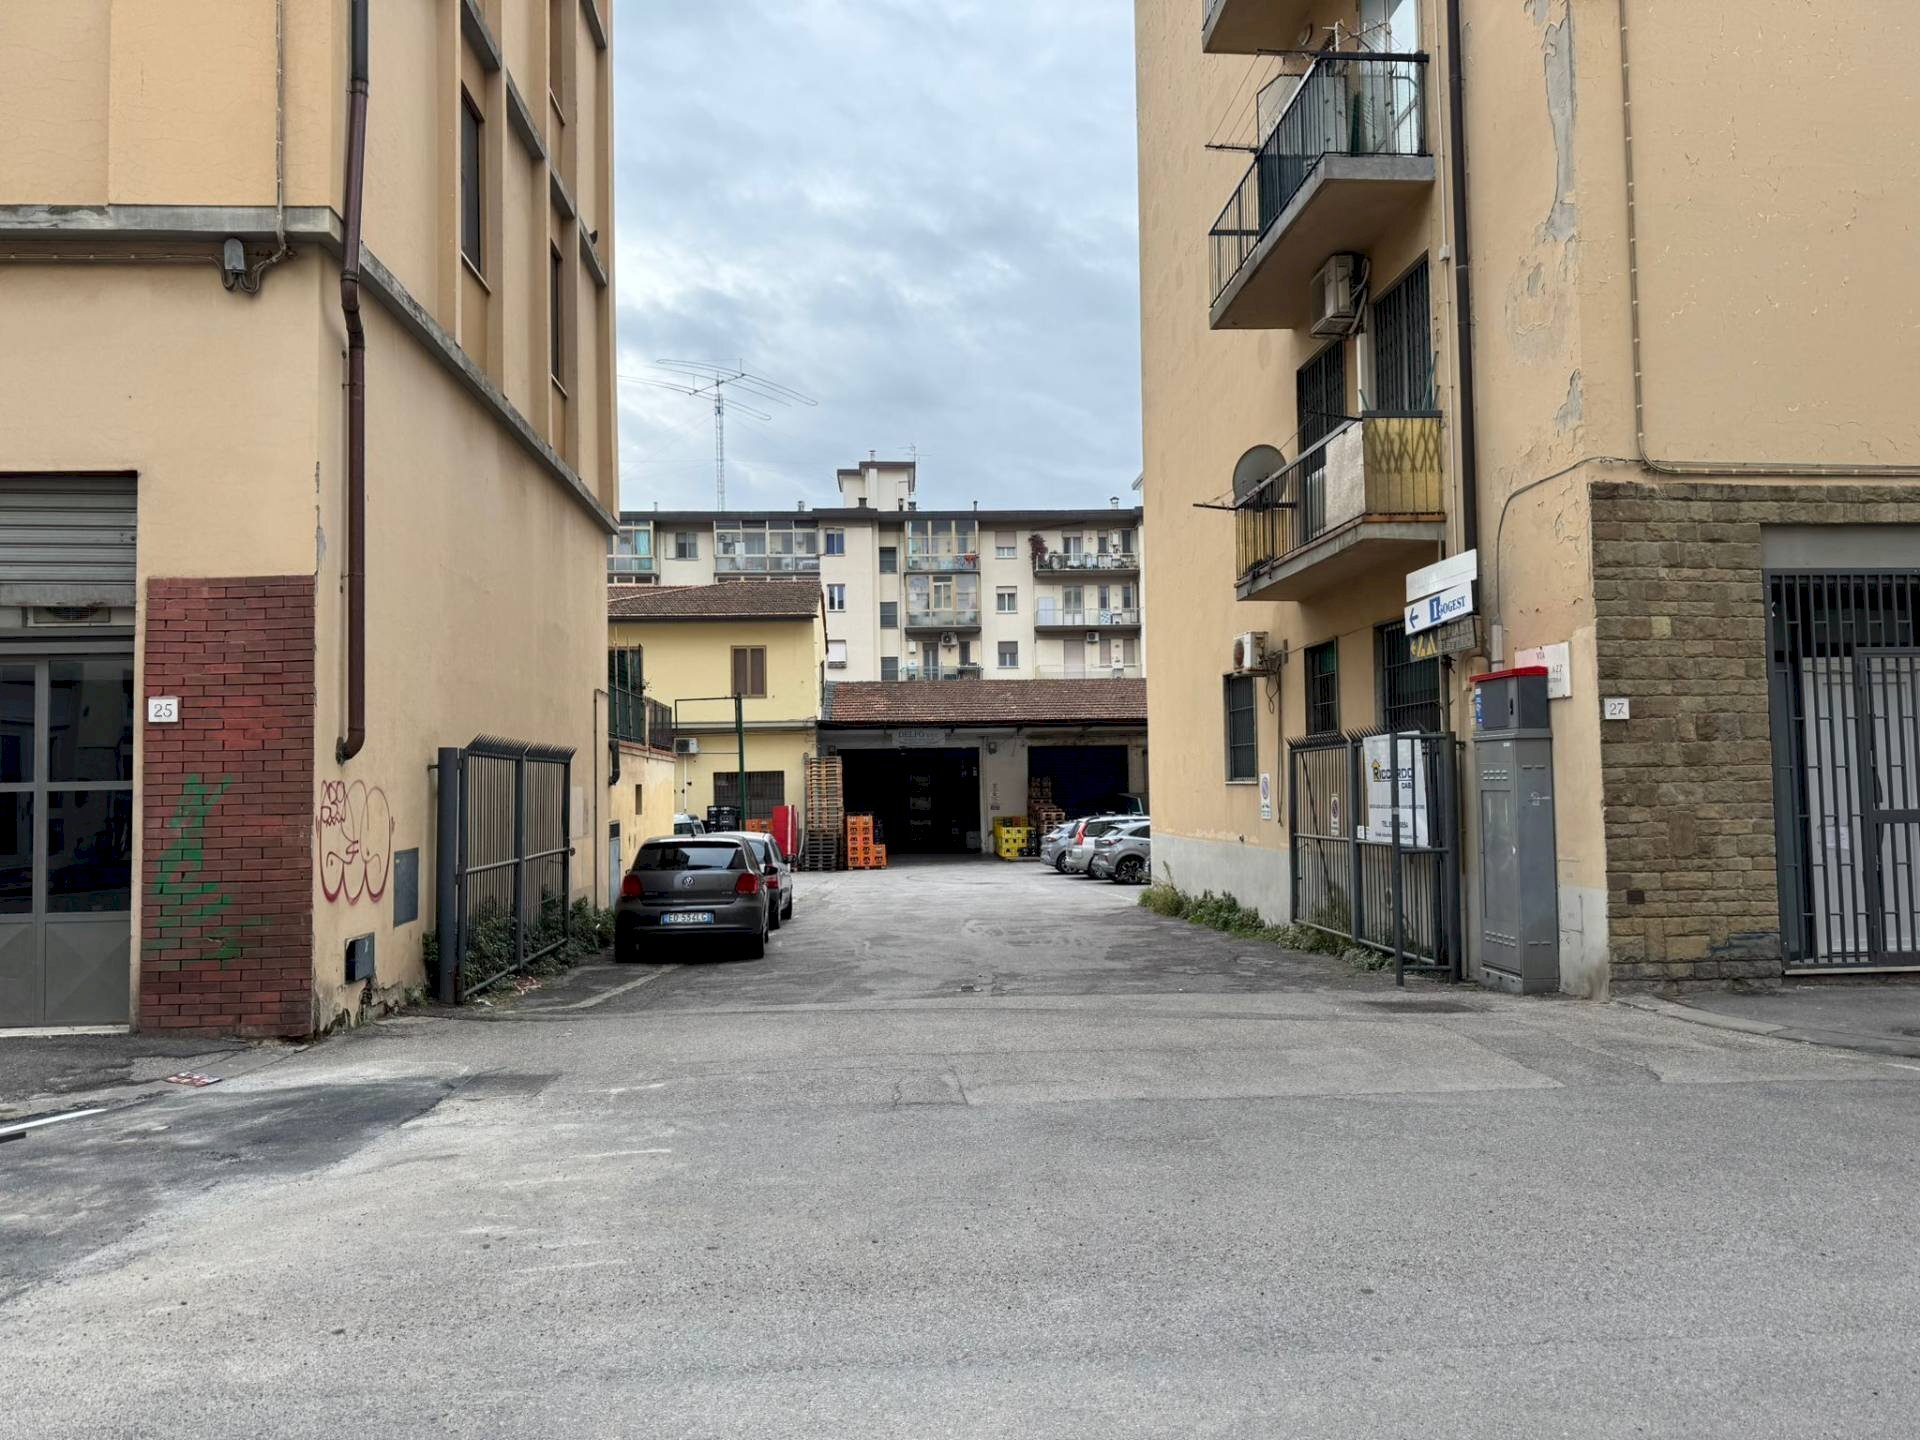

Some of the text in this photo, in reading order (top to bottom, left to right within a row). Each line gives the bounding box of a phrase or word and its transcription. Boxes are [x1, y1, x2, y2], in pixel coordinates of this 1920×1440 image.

[153, 703, 173, 718] 25
[1609, 702, 1625, 716] 27
[1373, 767, 1413, 780] RICCRDO
